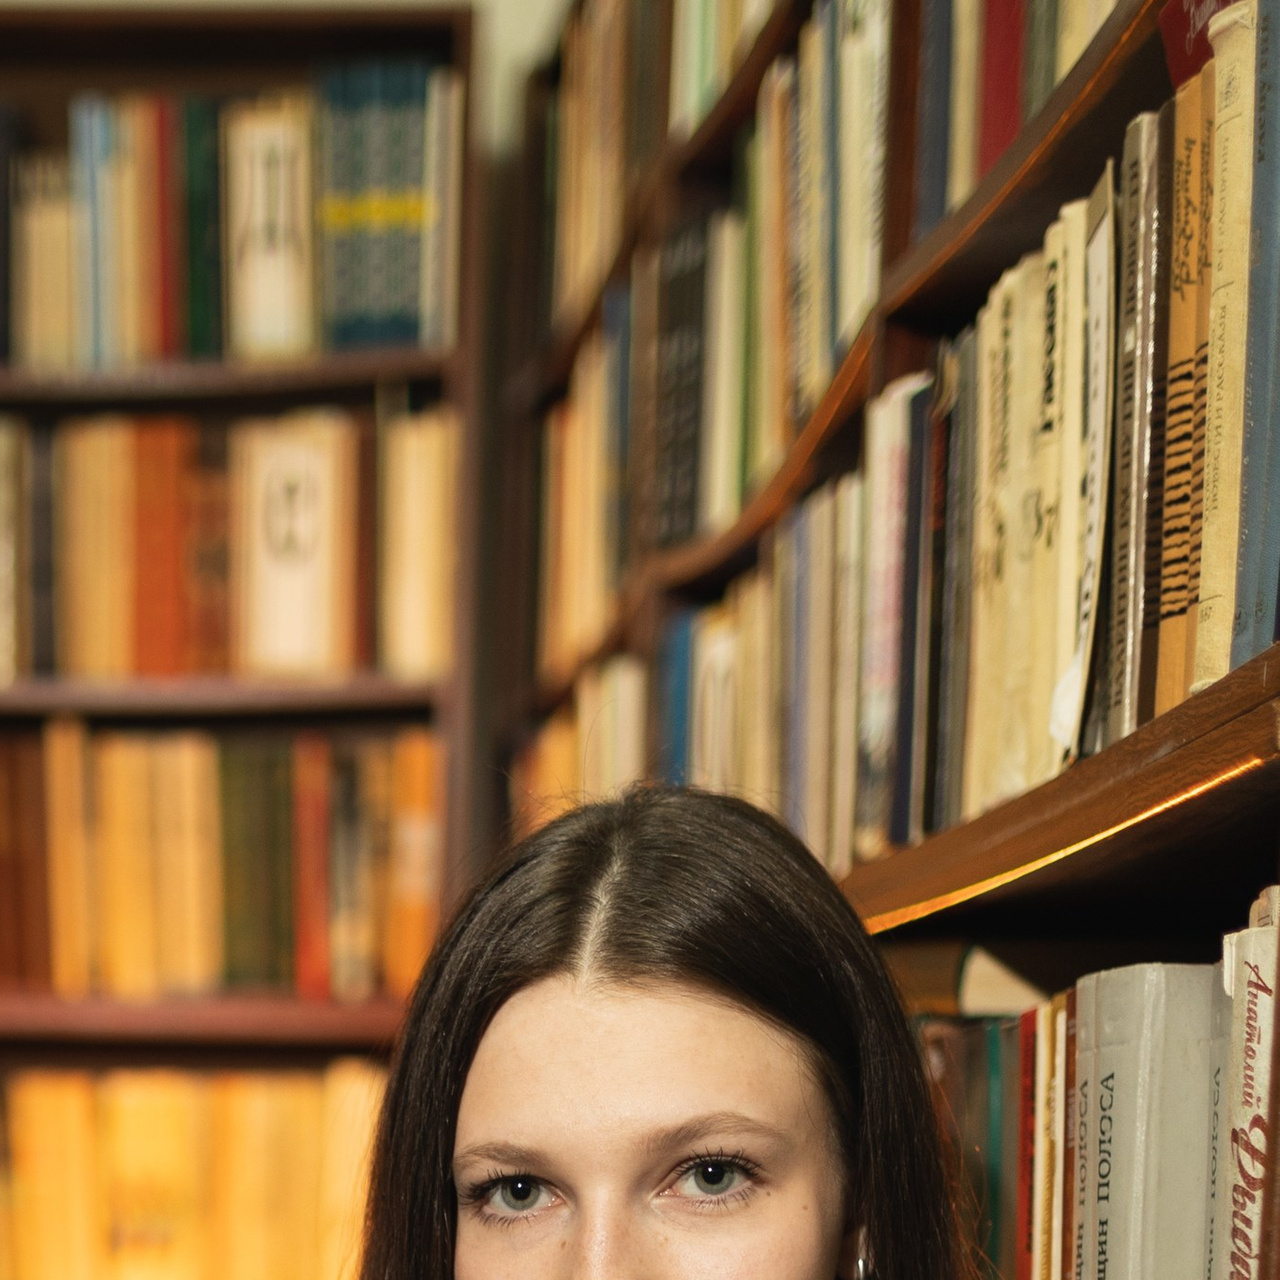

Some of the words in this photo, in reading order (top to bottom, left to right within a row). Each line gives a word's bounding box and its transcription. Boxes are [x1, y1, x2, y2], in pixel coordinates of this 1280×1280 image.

[1117, 357, 1133, 530] РАСПУТИН
[1240, 960, 1273, 1110] Анатолий
[1076, 1079, 1090, 1206] ПОЛОСА
[1096, 1071, 1116, 1205] ПОЛОСА
[1208, 1066, 1222, 1201] ПОЛОСА
